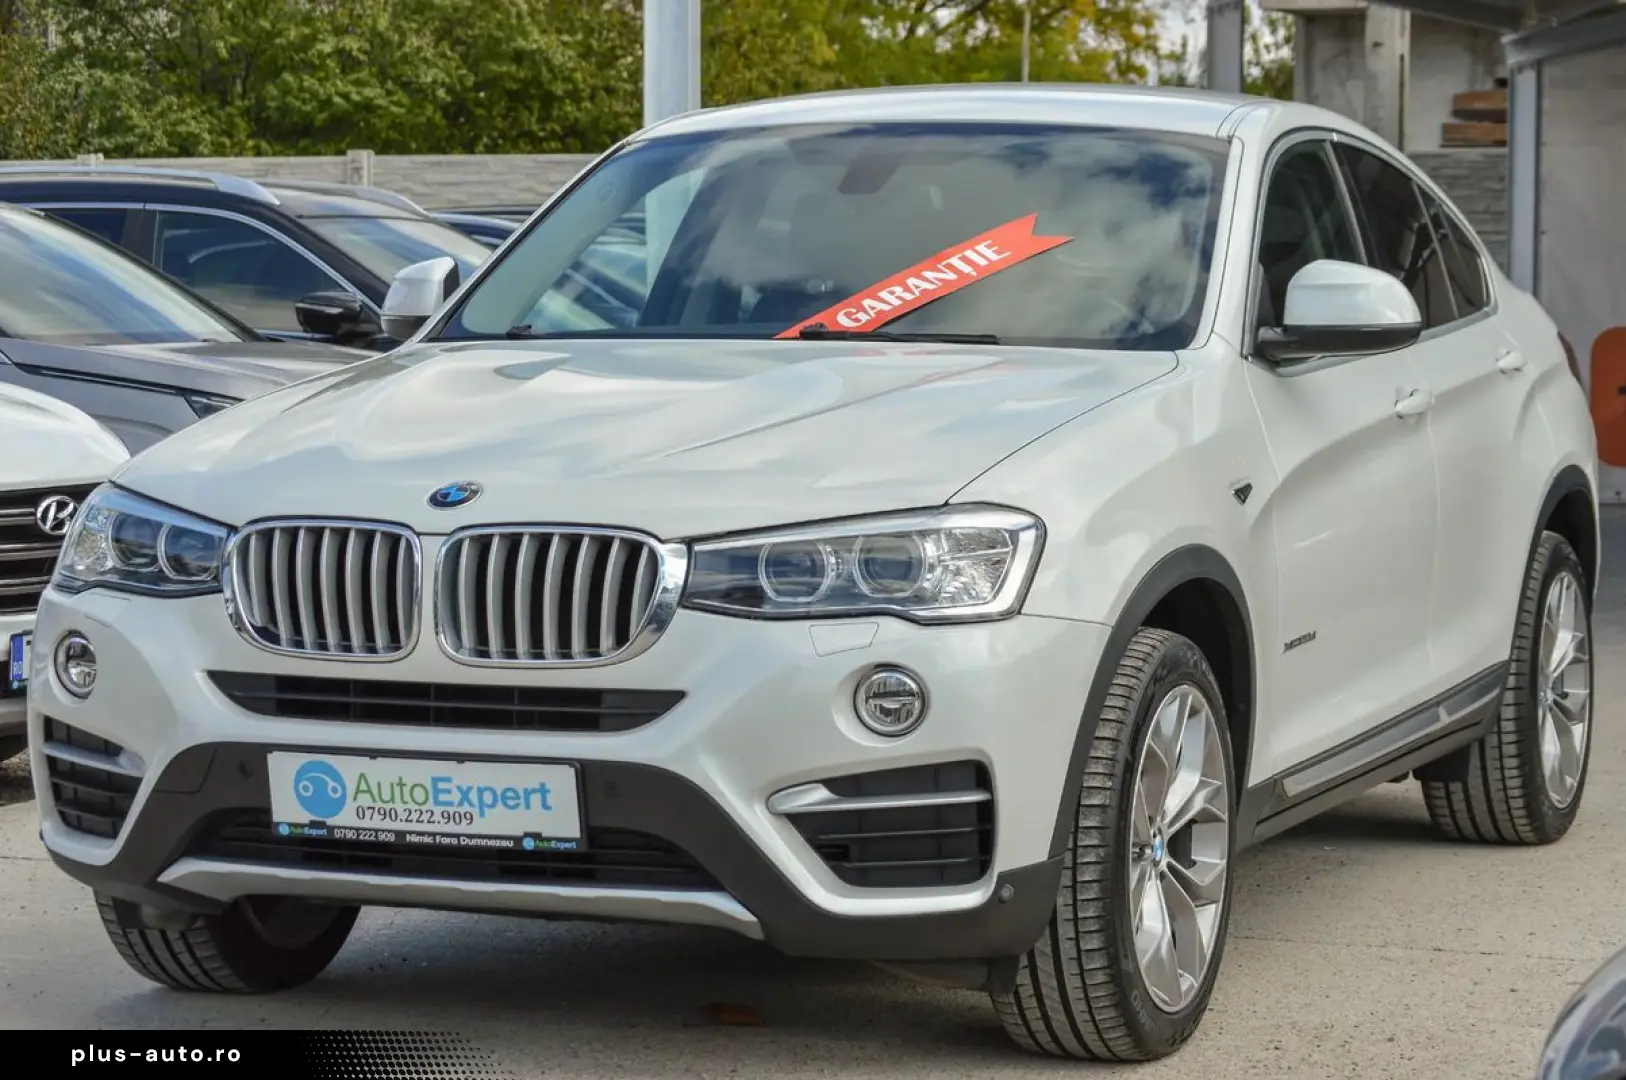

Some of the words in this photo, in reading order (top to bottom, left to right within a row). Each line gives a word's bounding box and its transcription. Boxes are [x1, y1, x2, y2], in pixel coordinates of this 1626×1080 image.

[352, 771, 553, 819] AutoExpert
[356, 805, 474, 826] 0790.222.909
[333, 828, 358, 839] 0790
[358, 830, 377, 841] 222
[377, 831, 396, 842] 909
[405, 833, 434, 844] Nimic
[460, 836, 514, 848] Dumnezeu
